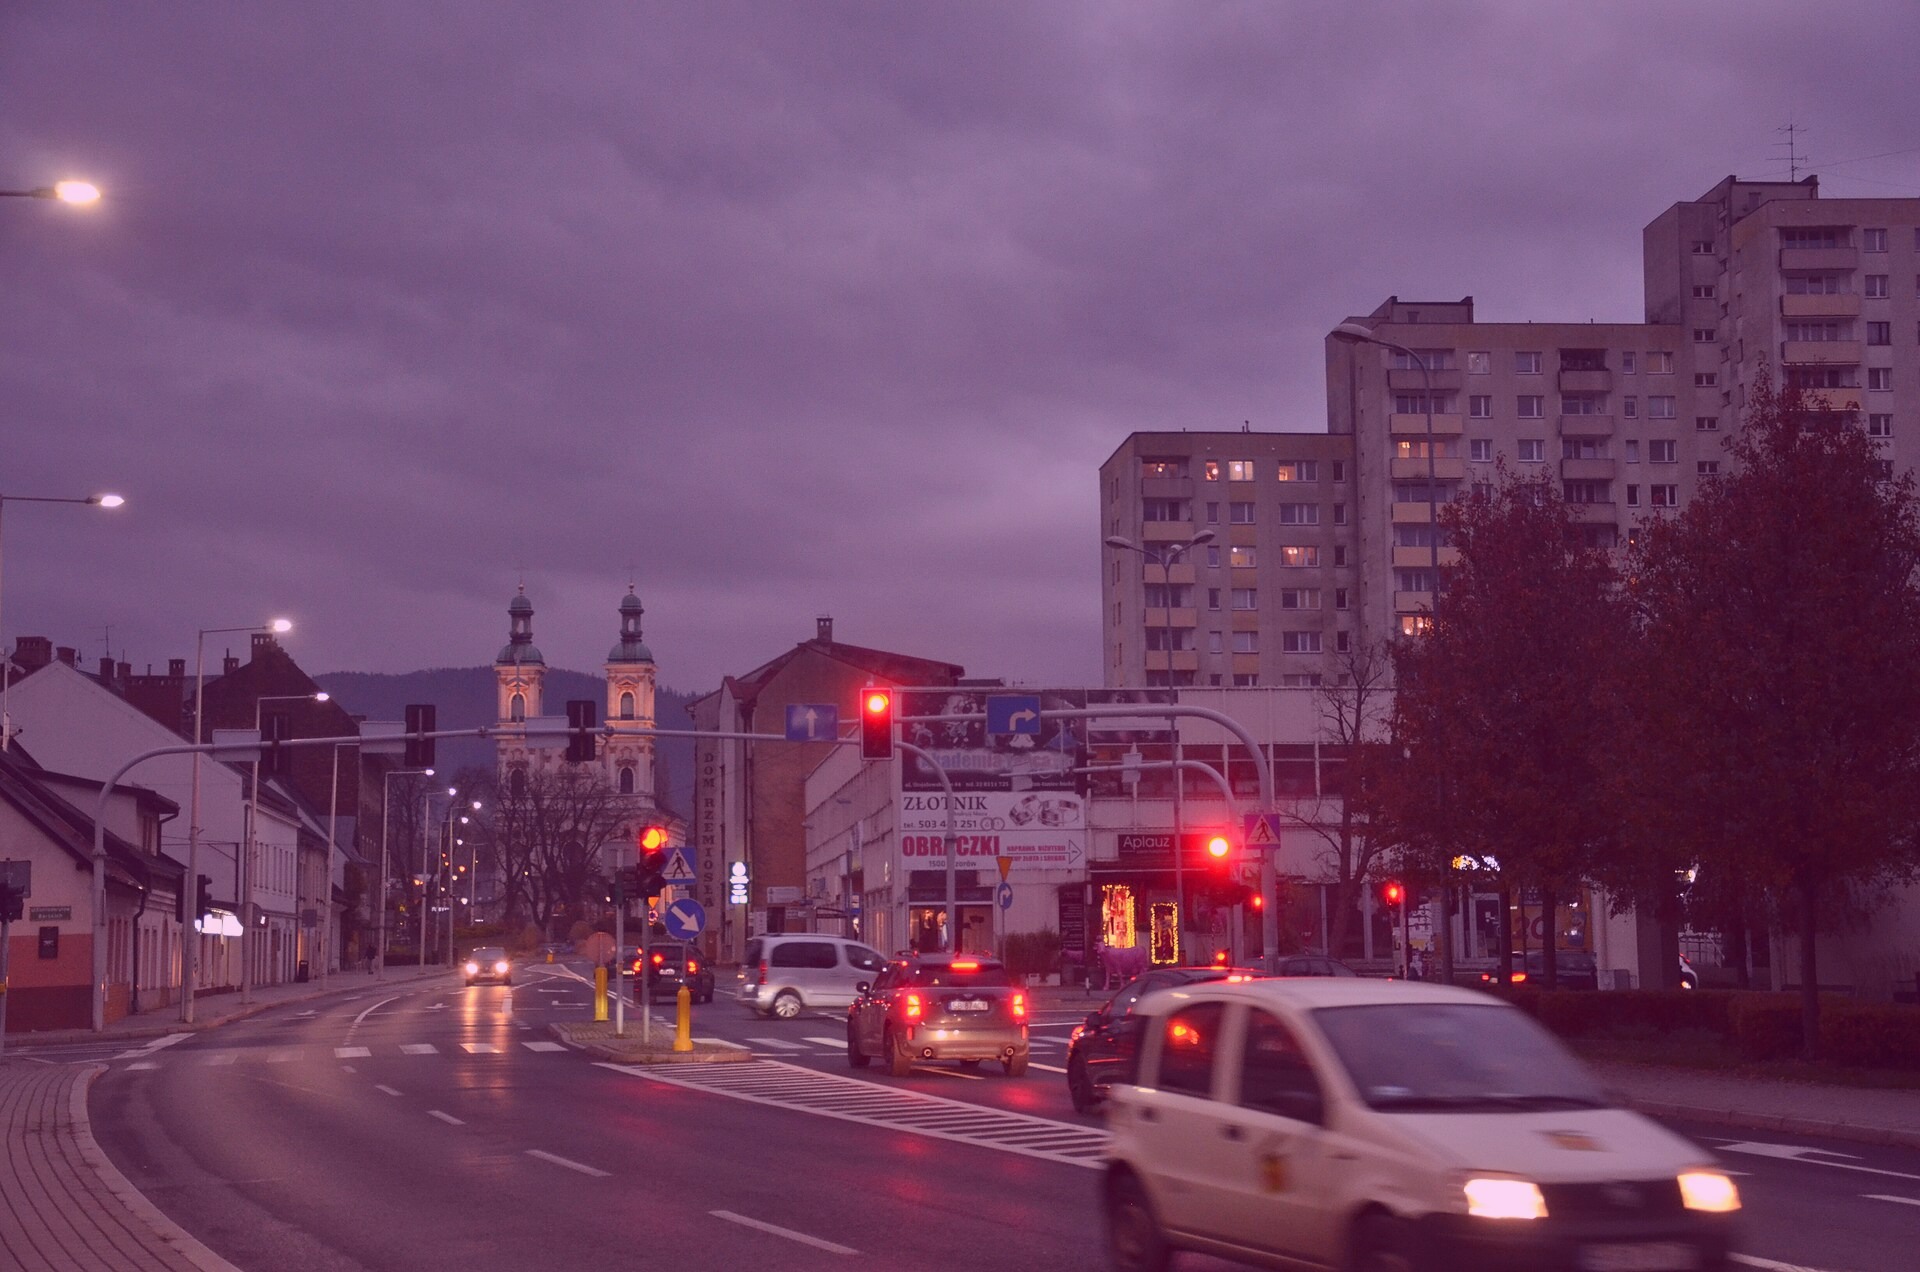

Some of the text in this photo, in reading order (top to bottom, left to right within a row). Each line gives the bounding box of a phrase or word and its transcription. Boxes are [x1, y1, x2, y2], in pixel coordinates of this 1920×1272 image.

[703, 752, 715, 788] DOM
[903, 796, 988, 810] ZŁOTNIK
[919, 820, 936, 828] 503
[960, 820, 976, 828] 251
[1123, 836, 1170, 850] Aplauz
